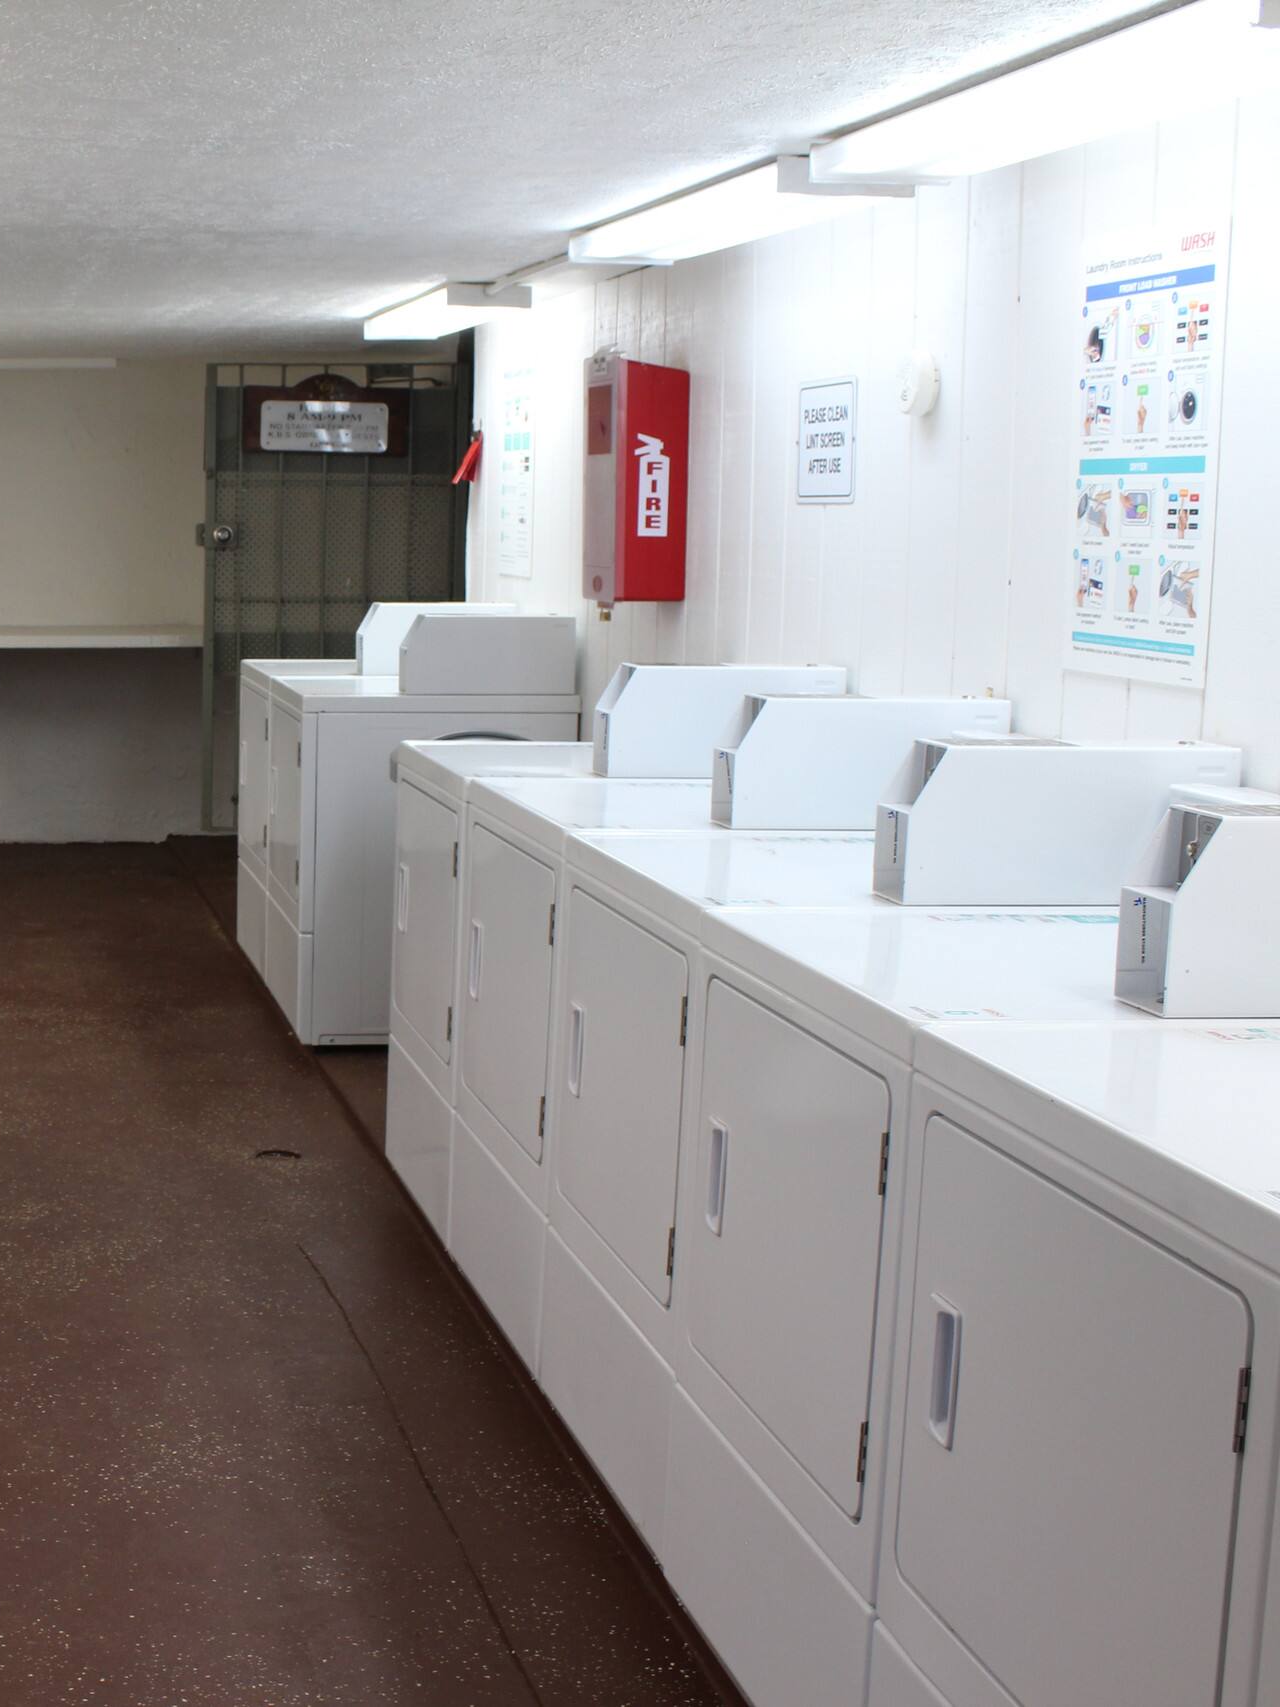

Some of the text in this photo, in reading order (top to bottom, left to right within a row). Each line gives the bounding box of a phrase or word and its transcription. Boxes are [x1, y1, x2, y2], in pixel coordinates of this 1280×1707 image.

[1181, 231, 1216, 252] WASH
[804, 405, 849, 424] PLEASE CLEAN
[806, 431, 845, 449] LINT SCREEN
[808, 457, 841, 474] AFTER USE
[645, 461, 664, 529] FIRE
